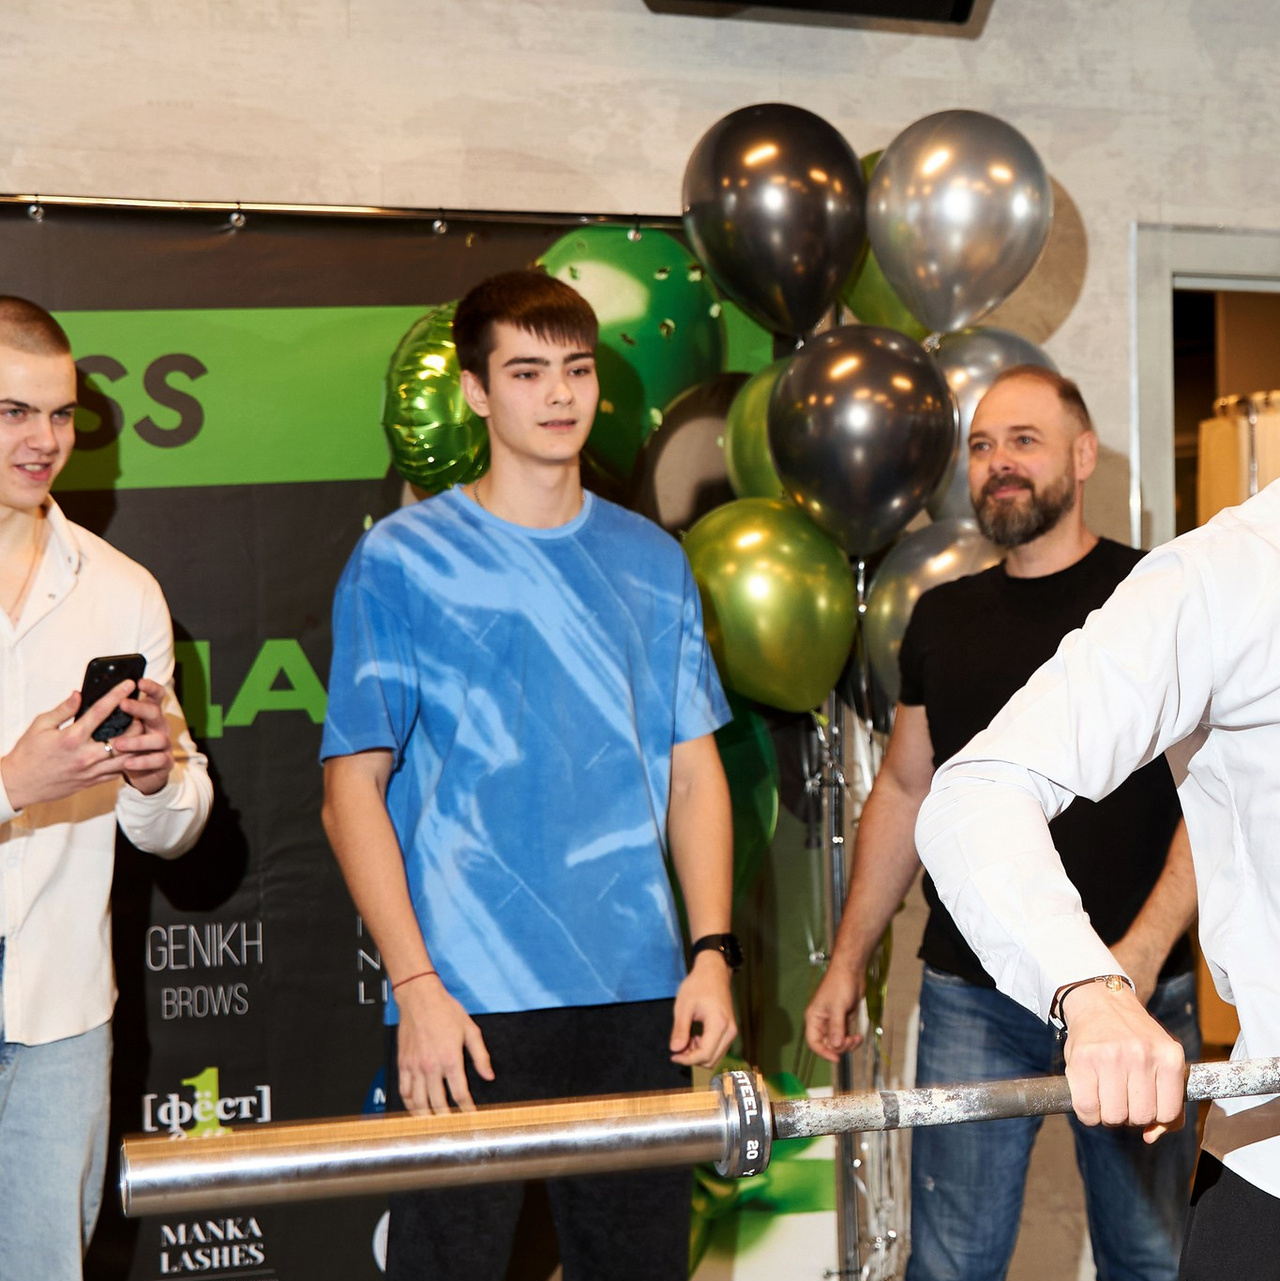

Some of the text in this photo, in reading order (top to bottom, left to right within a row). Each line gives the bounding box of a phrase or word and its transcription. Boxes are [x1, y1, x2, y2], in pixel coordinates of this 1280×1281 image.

[145, 920, 264, 972] GENIKH
[161, 982, 249, 1020] BROWS
[746, 1139, 760, 1160] 20
[161, 1217, 263, 1247] MANKA
[160, 1243, 265, 1274] LASHES
